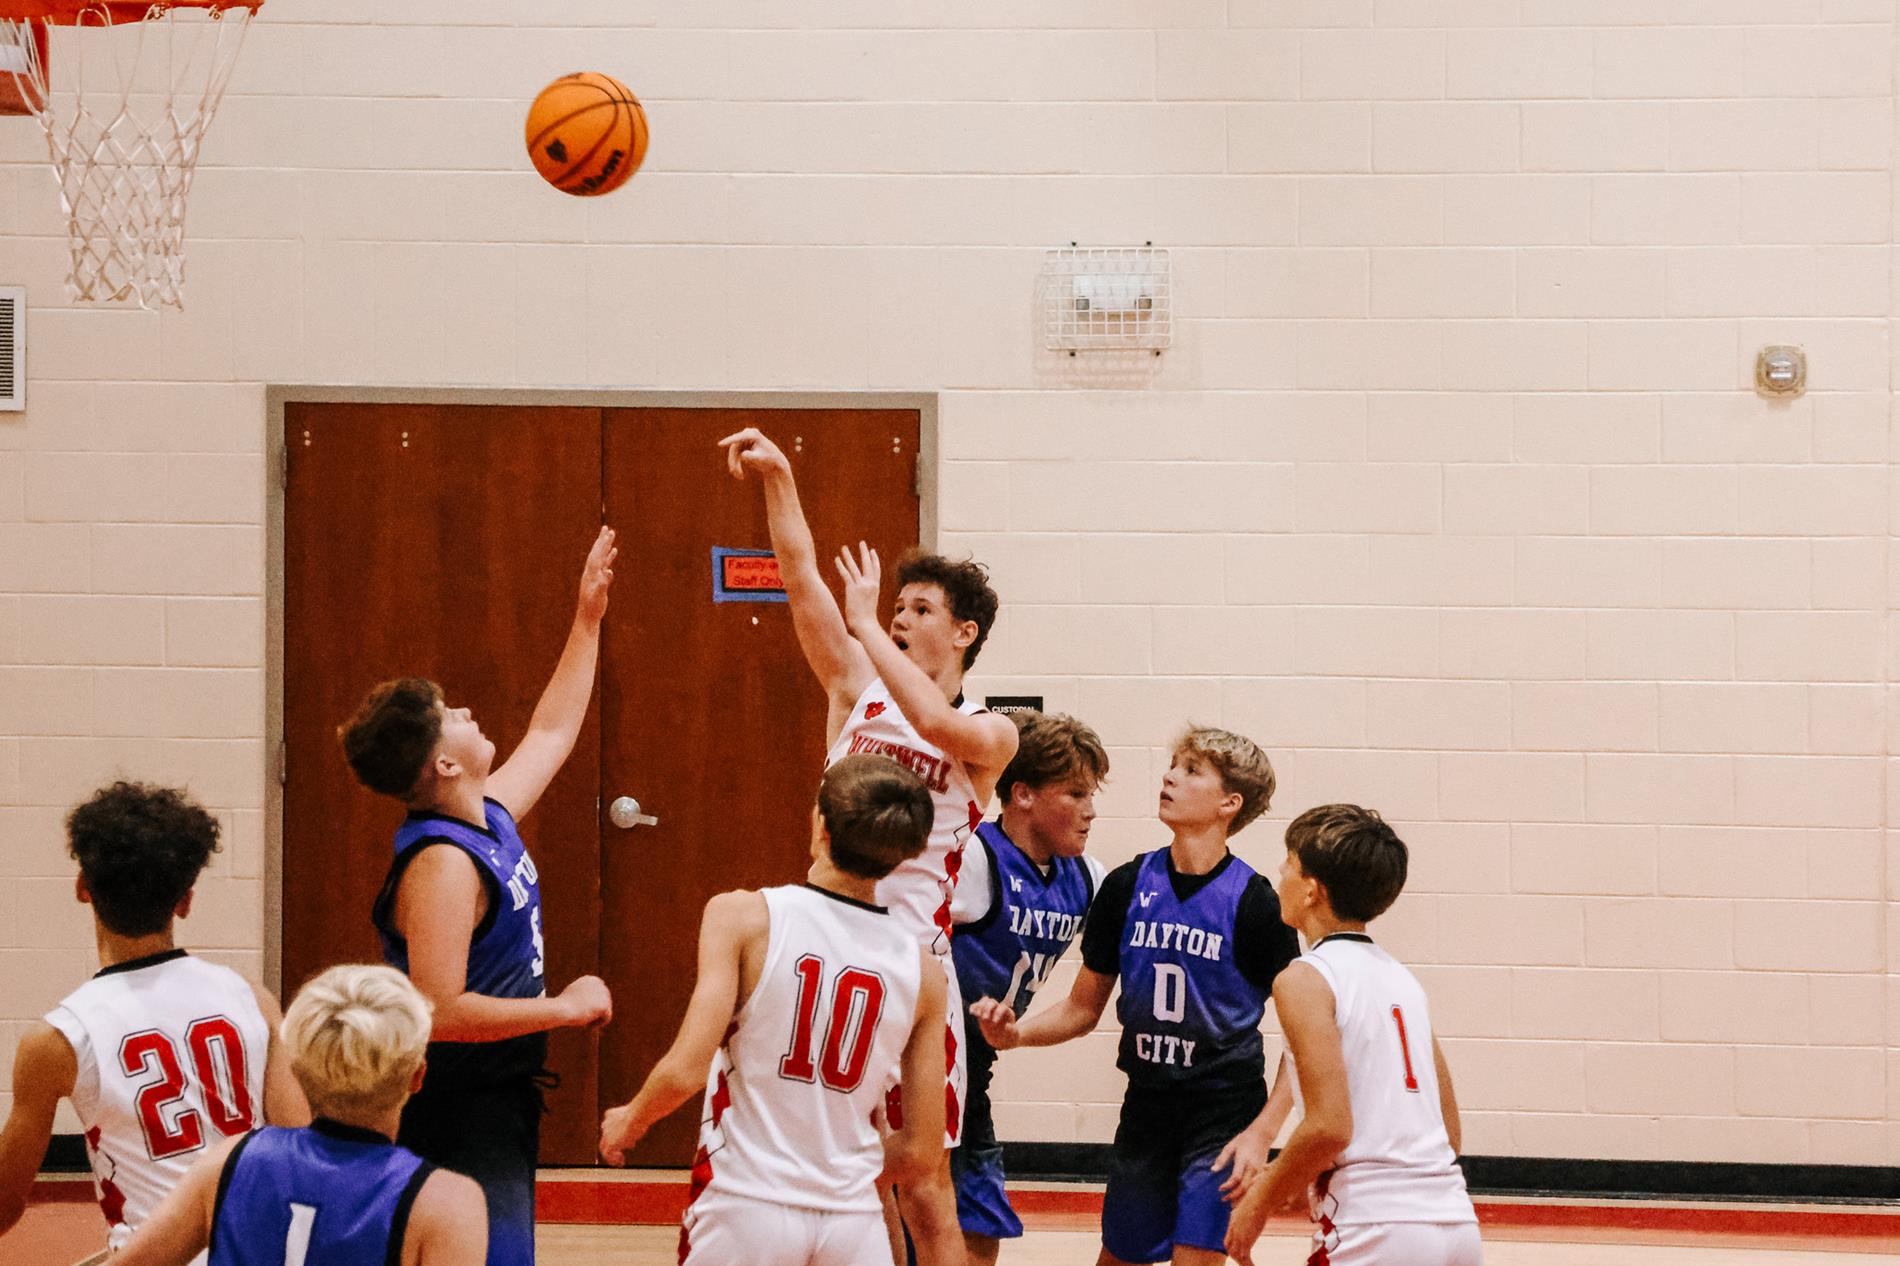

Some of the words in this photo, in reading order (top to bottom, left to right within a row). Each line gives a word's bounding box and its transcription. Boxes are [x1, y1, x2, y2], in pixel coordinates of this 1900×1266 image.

[728, 559, 767, 572] Faculty
[734, 575, 758, 586] Staff
[1129, 920, 1224, 961] DAYTON
[1152, 962, 1187, 1024] 0
[778, 953, 887, 1094] 10
[1391, 1004, 1420, 1093] 1
[1136, 1033, 1196, 1068] CITY
[117, 1014, 257, 1161] 20
